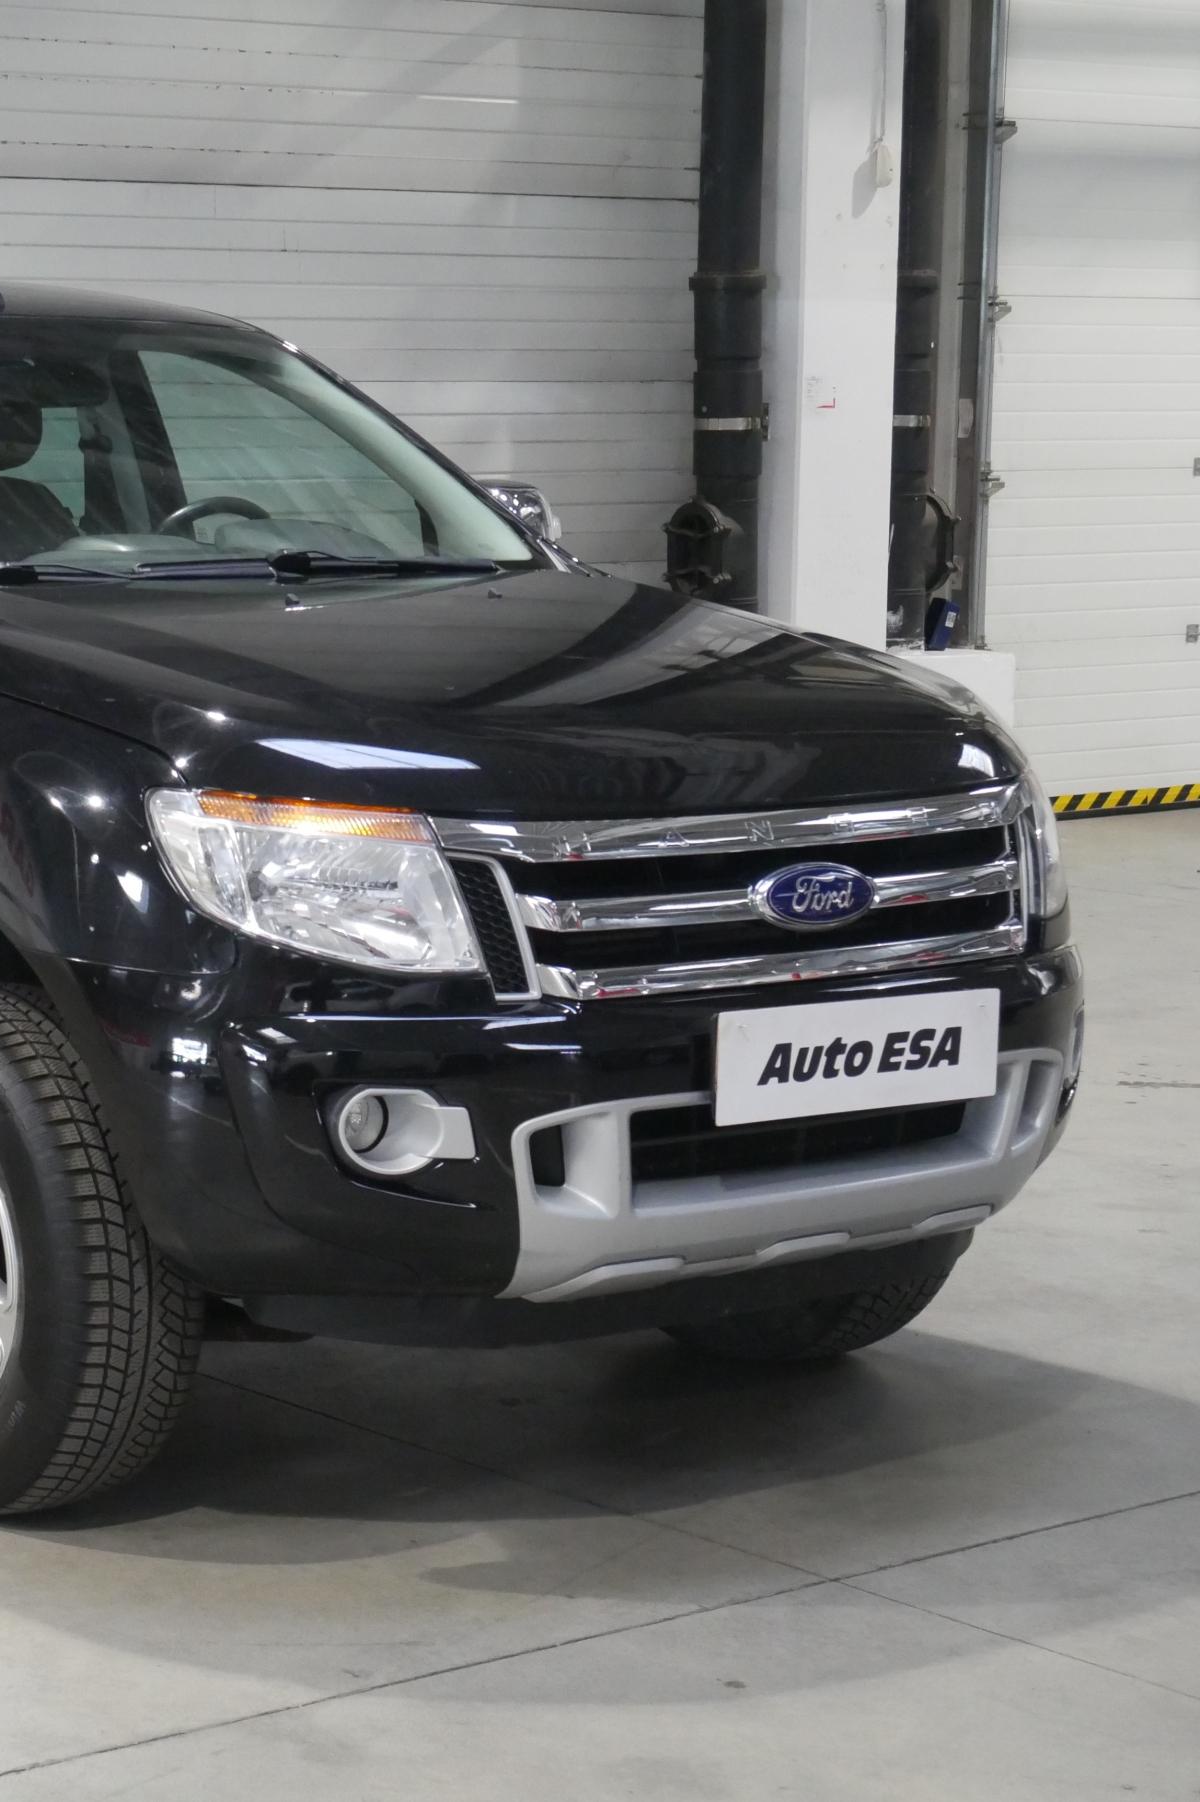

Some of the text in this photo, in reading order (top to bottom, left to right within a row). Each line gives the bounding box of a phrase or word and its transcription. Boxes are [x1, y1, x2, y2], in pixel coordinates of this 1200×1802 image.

[780, 871, 855, 913] Ford
[757, 1027, 962, 1086] Auto ESA
